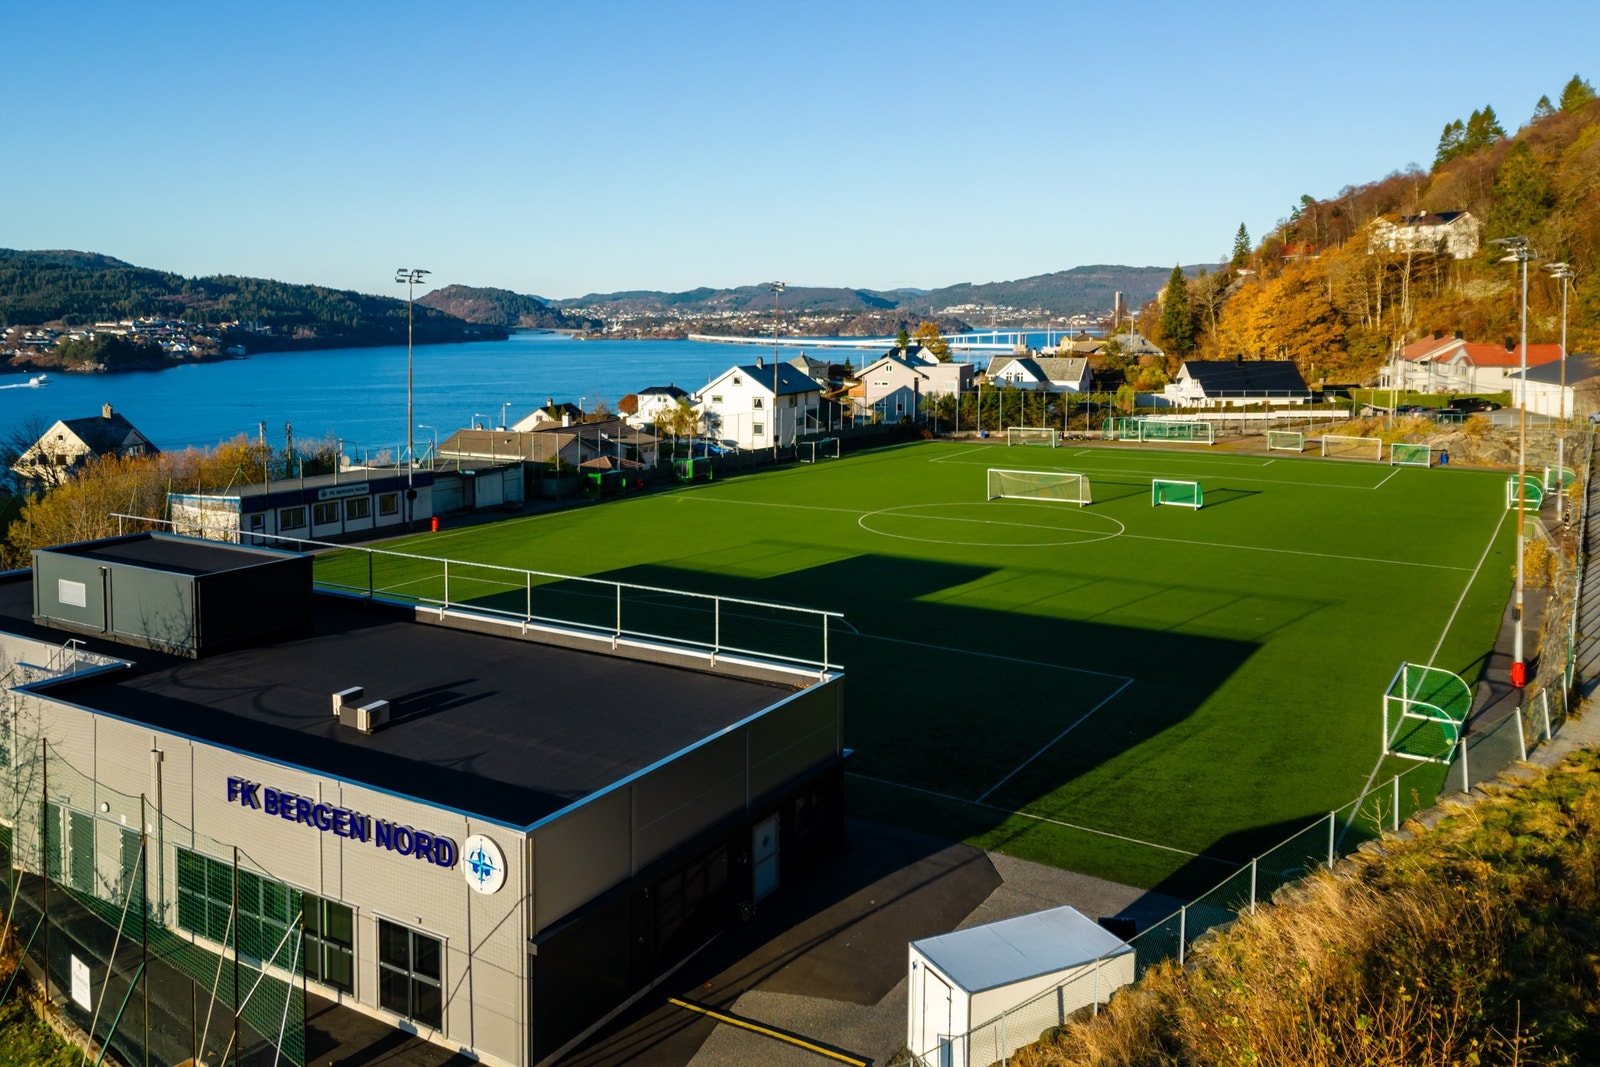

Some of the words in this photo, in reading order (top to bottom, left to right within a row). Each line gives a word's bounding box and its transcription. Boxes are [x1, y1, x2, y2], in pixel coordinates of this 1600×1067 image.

[227, 776, 261, 810] FK
[264, 786, 371, 843] BERGEN
[375, 818, 460, 868] NORD
